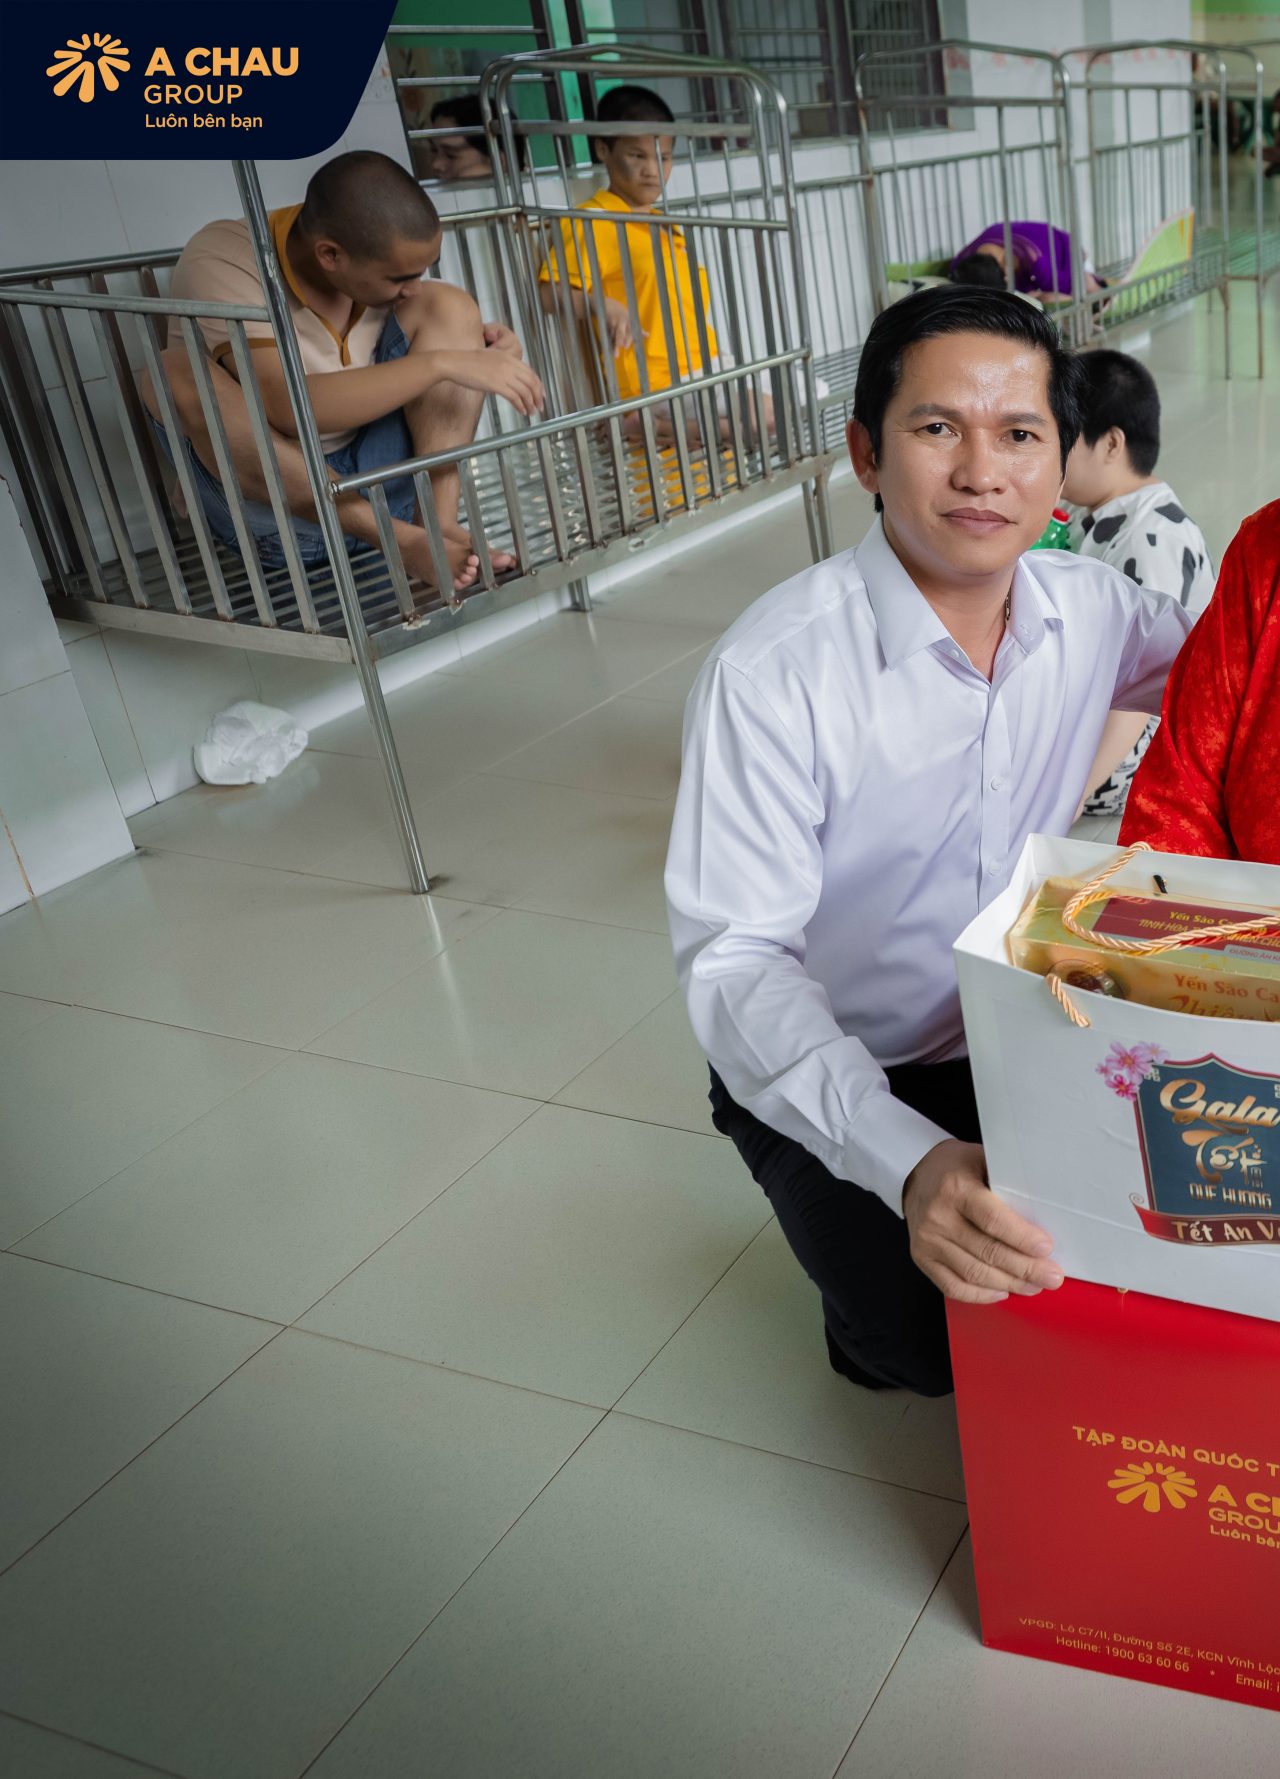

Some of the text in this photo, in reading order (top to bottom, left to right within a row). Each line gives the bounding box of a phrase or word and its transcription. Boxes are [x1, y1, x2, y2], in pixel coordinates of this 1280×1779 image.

[1173, 973, 1208, 993] Yến
[1171, 1220, 1213, 1242] Tết
[1223, 1222, 1254, 1241] An
[1072, 1426, 1115, 1447] TẬP
[1121, 1436, 1186, 1459] ĐOÀN
[1208, 1484, 1238, 1507] A
[1210, 1524, 1251, 1542] Luôn
[1113, 1632, 1153, 1650] Đường
[1156, 1640, 1173, 1652] Số
[1197, 1649, 1224, 1664] KCN
[1227, 1655, 1255, 1670] Vĩnh
[1056, 1636, 1101, 1654] Hotline:
[1105, 1645, 1135, 1661] 1900
[1174, 1661, 1190, 1673] 66
[1236, 1674, 1273, 1691] Email:
